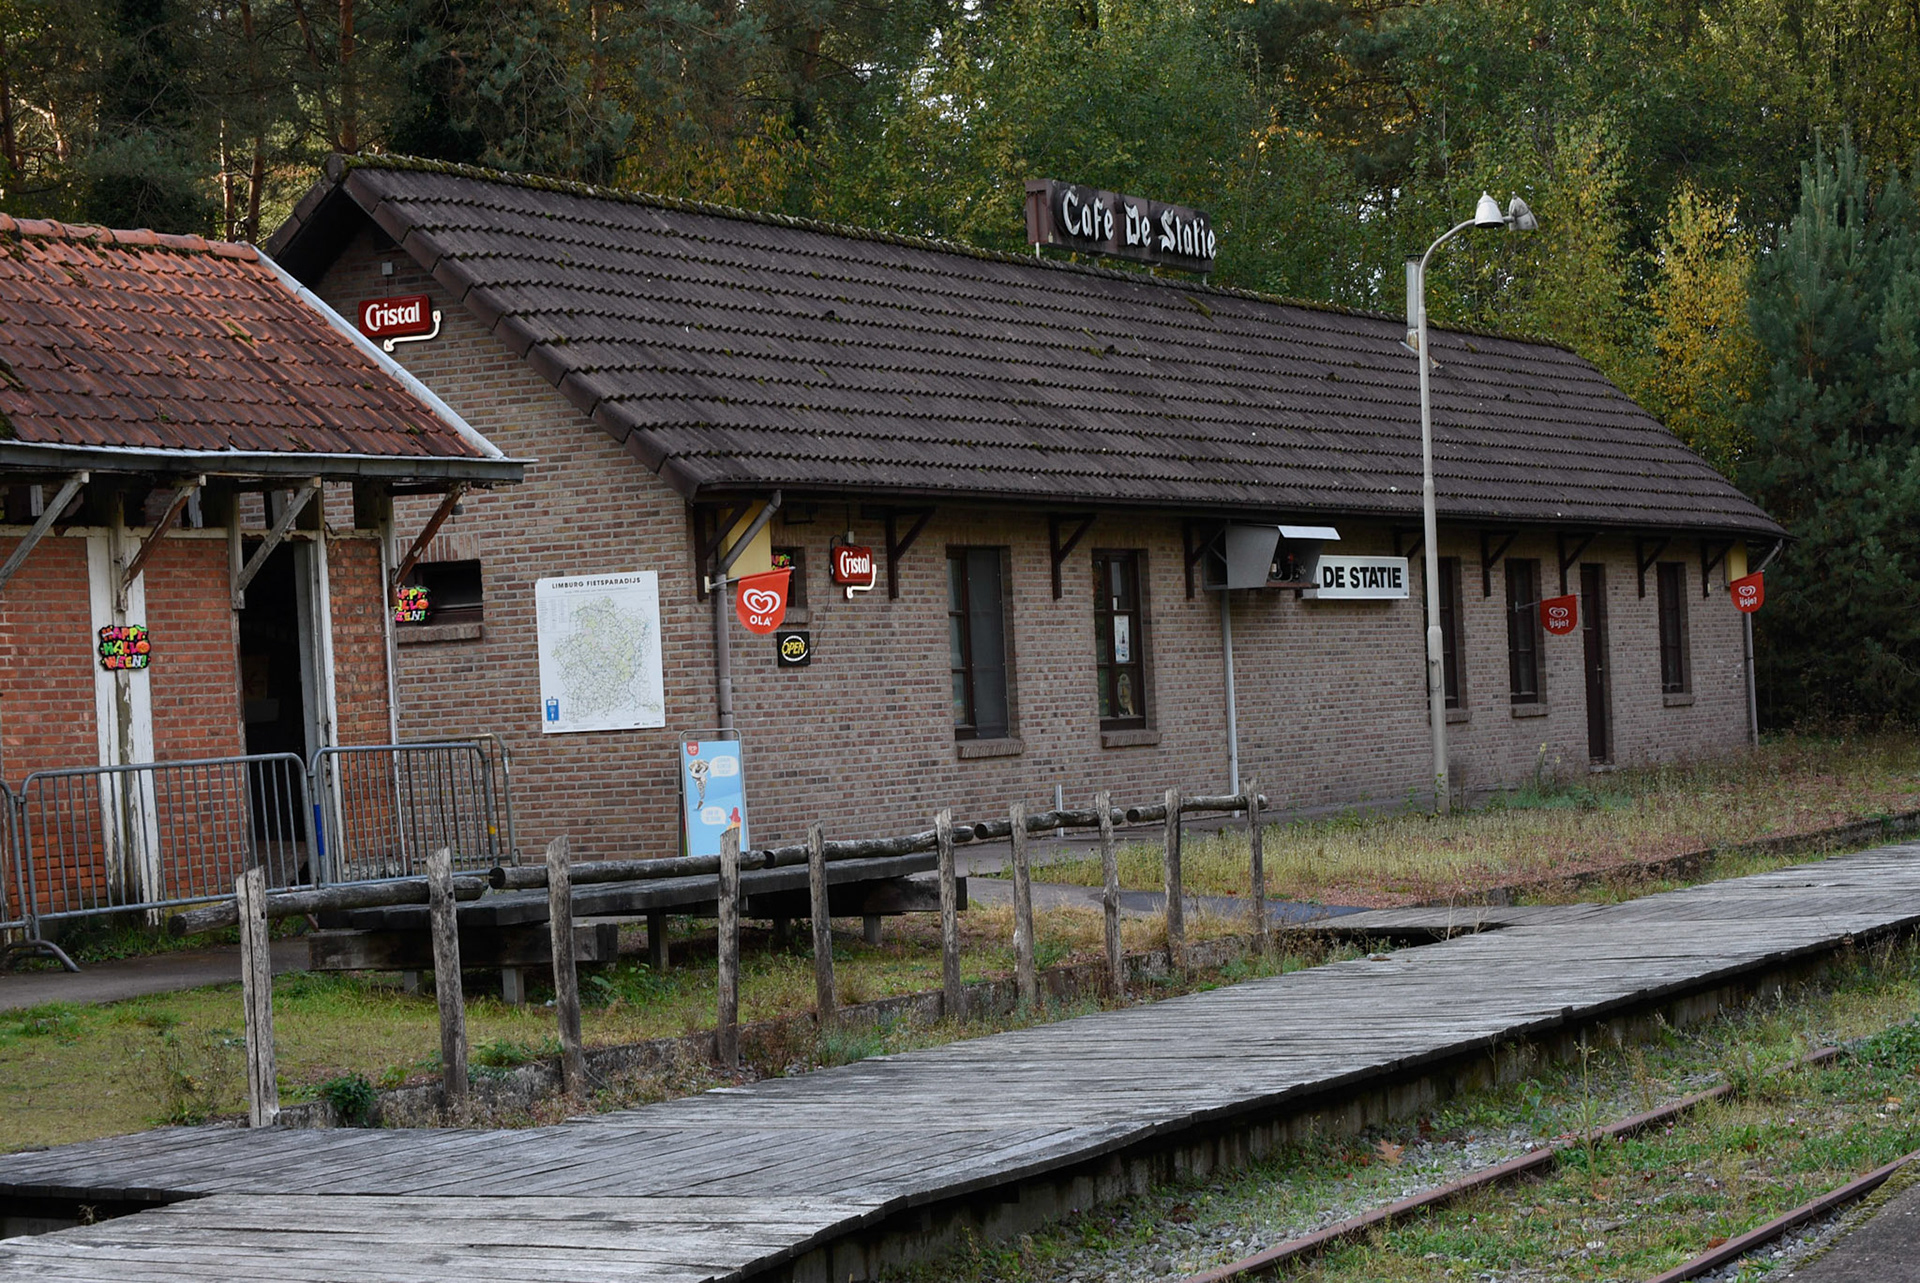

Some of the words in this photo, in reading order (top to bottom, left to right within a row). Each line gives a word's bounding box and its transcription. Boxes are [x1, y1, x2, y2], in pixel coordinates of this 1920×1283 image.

[1062, 188, 1114, 241] Cafe
[1124, 202, 1151, 247] De
[1158, 208, 1217, 260] Statie
[365, 301, 421, 332] Cristal
[840, 551, 870, 578] Cristal
[552, 581, 584, 589] LIMBURG
[586, 577, 641, 587] FIETSPARADIJS
[1322, 566, 1345, 588] DE
[1350, 566, 1402, 589] STATIE
[1549, 617, 1570, 629] ijsje?
[101, 626, 147, 641] HAPPY
[103, 640, 150, 656] HALLO
[781, 641, 806, 655] OPEN
[104, 654, 148, 669] WEEN!
